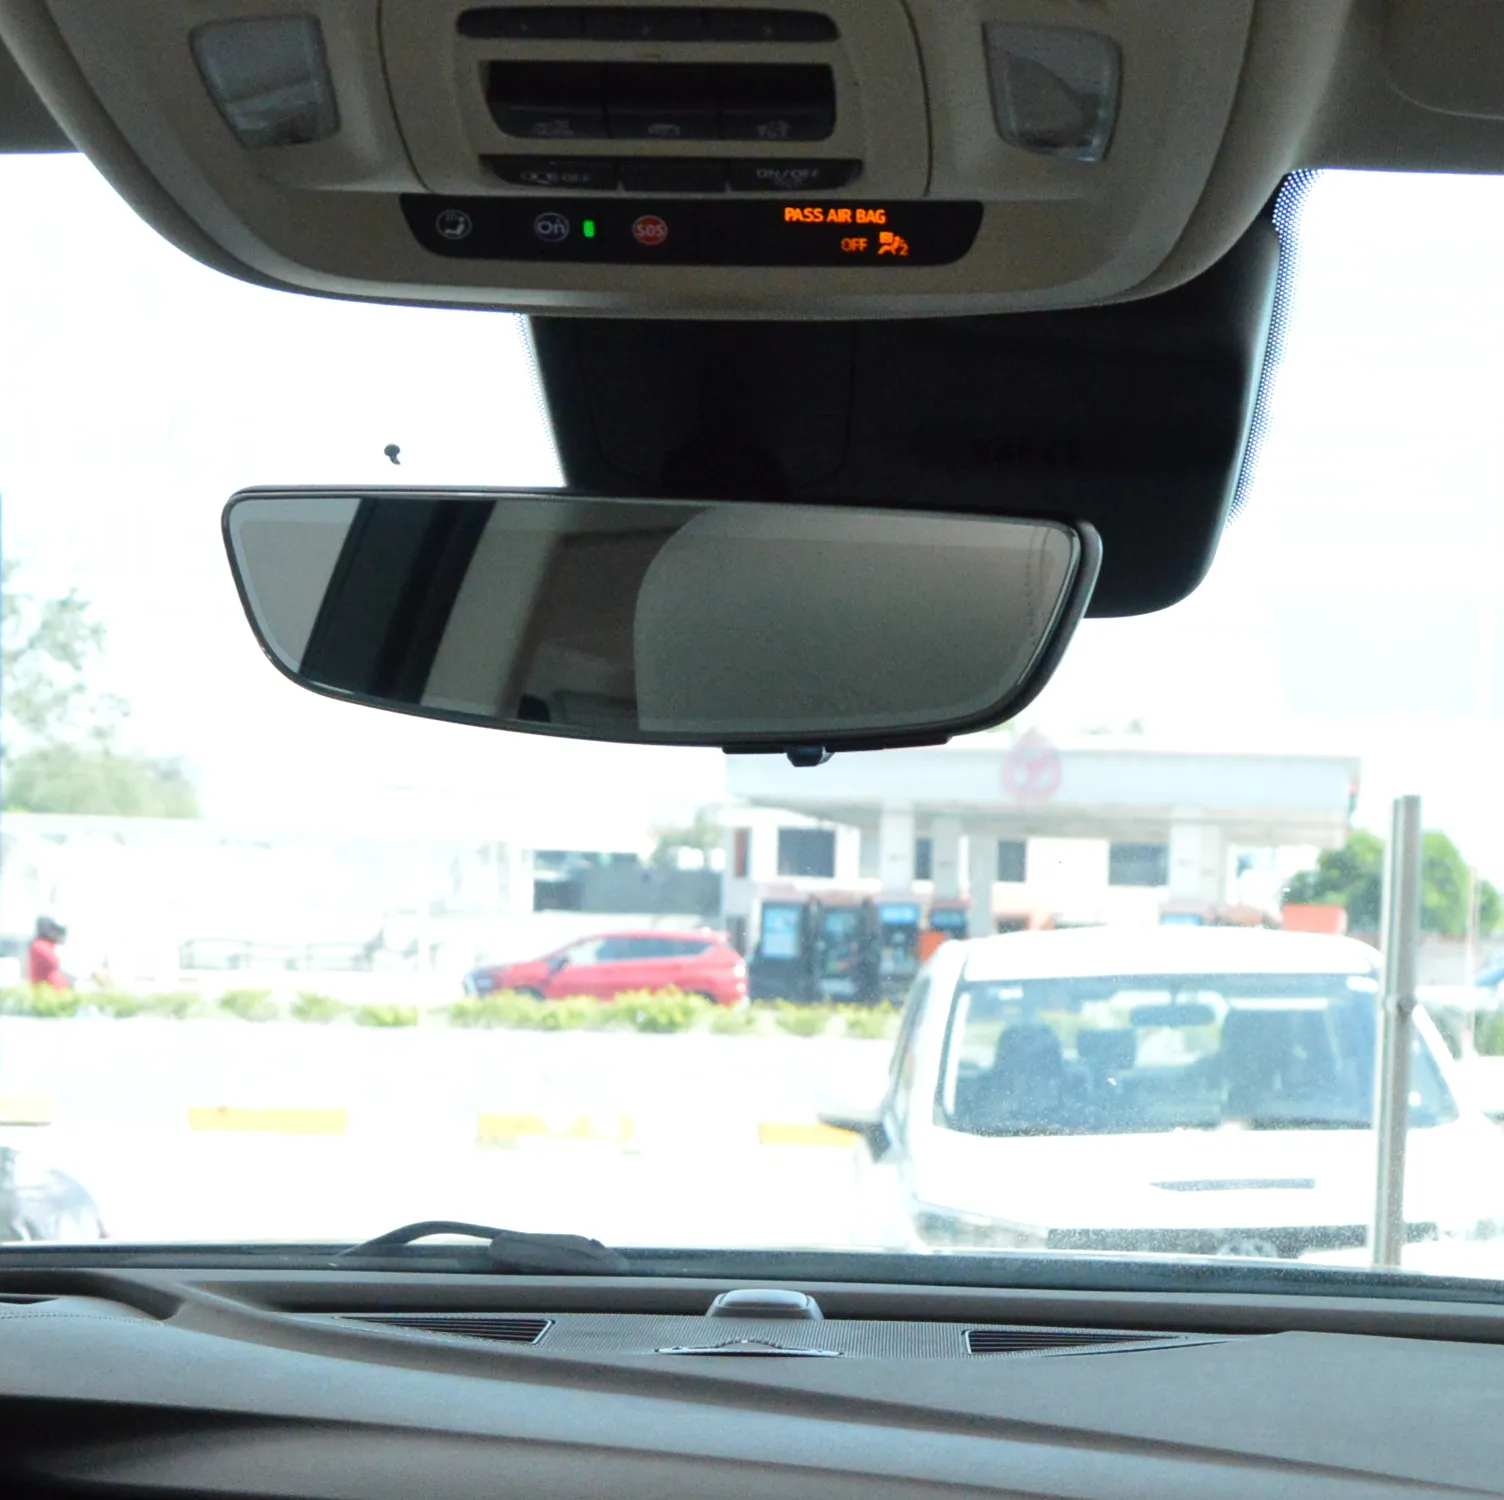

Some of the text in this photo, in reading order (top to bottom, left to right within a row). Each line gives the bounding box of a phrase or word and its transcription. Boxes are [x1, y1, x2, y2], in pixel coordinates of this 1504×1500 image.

[784, 207, 887, 224] PASS AIR BAG
[636, 224, 664, 238] SOS
[841, 238, 868, 252] OFF
